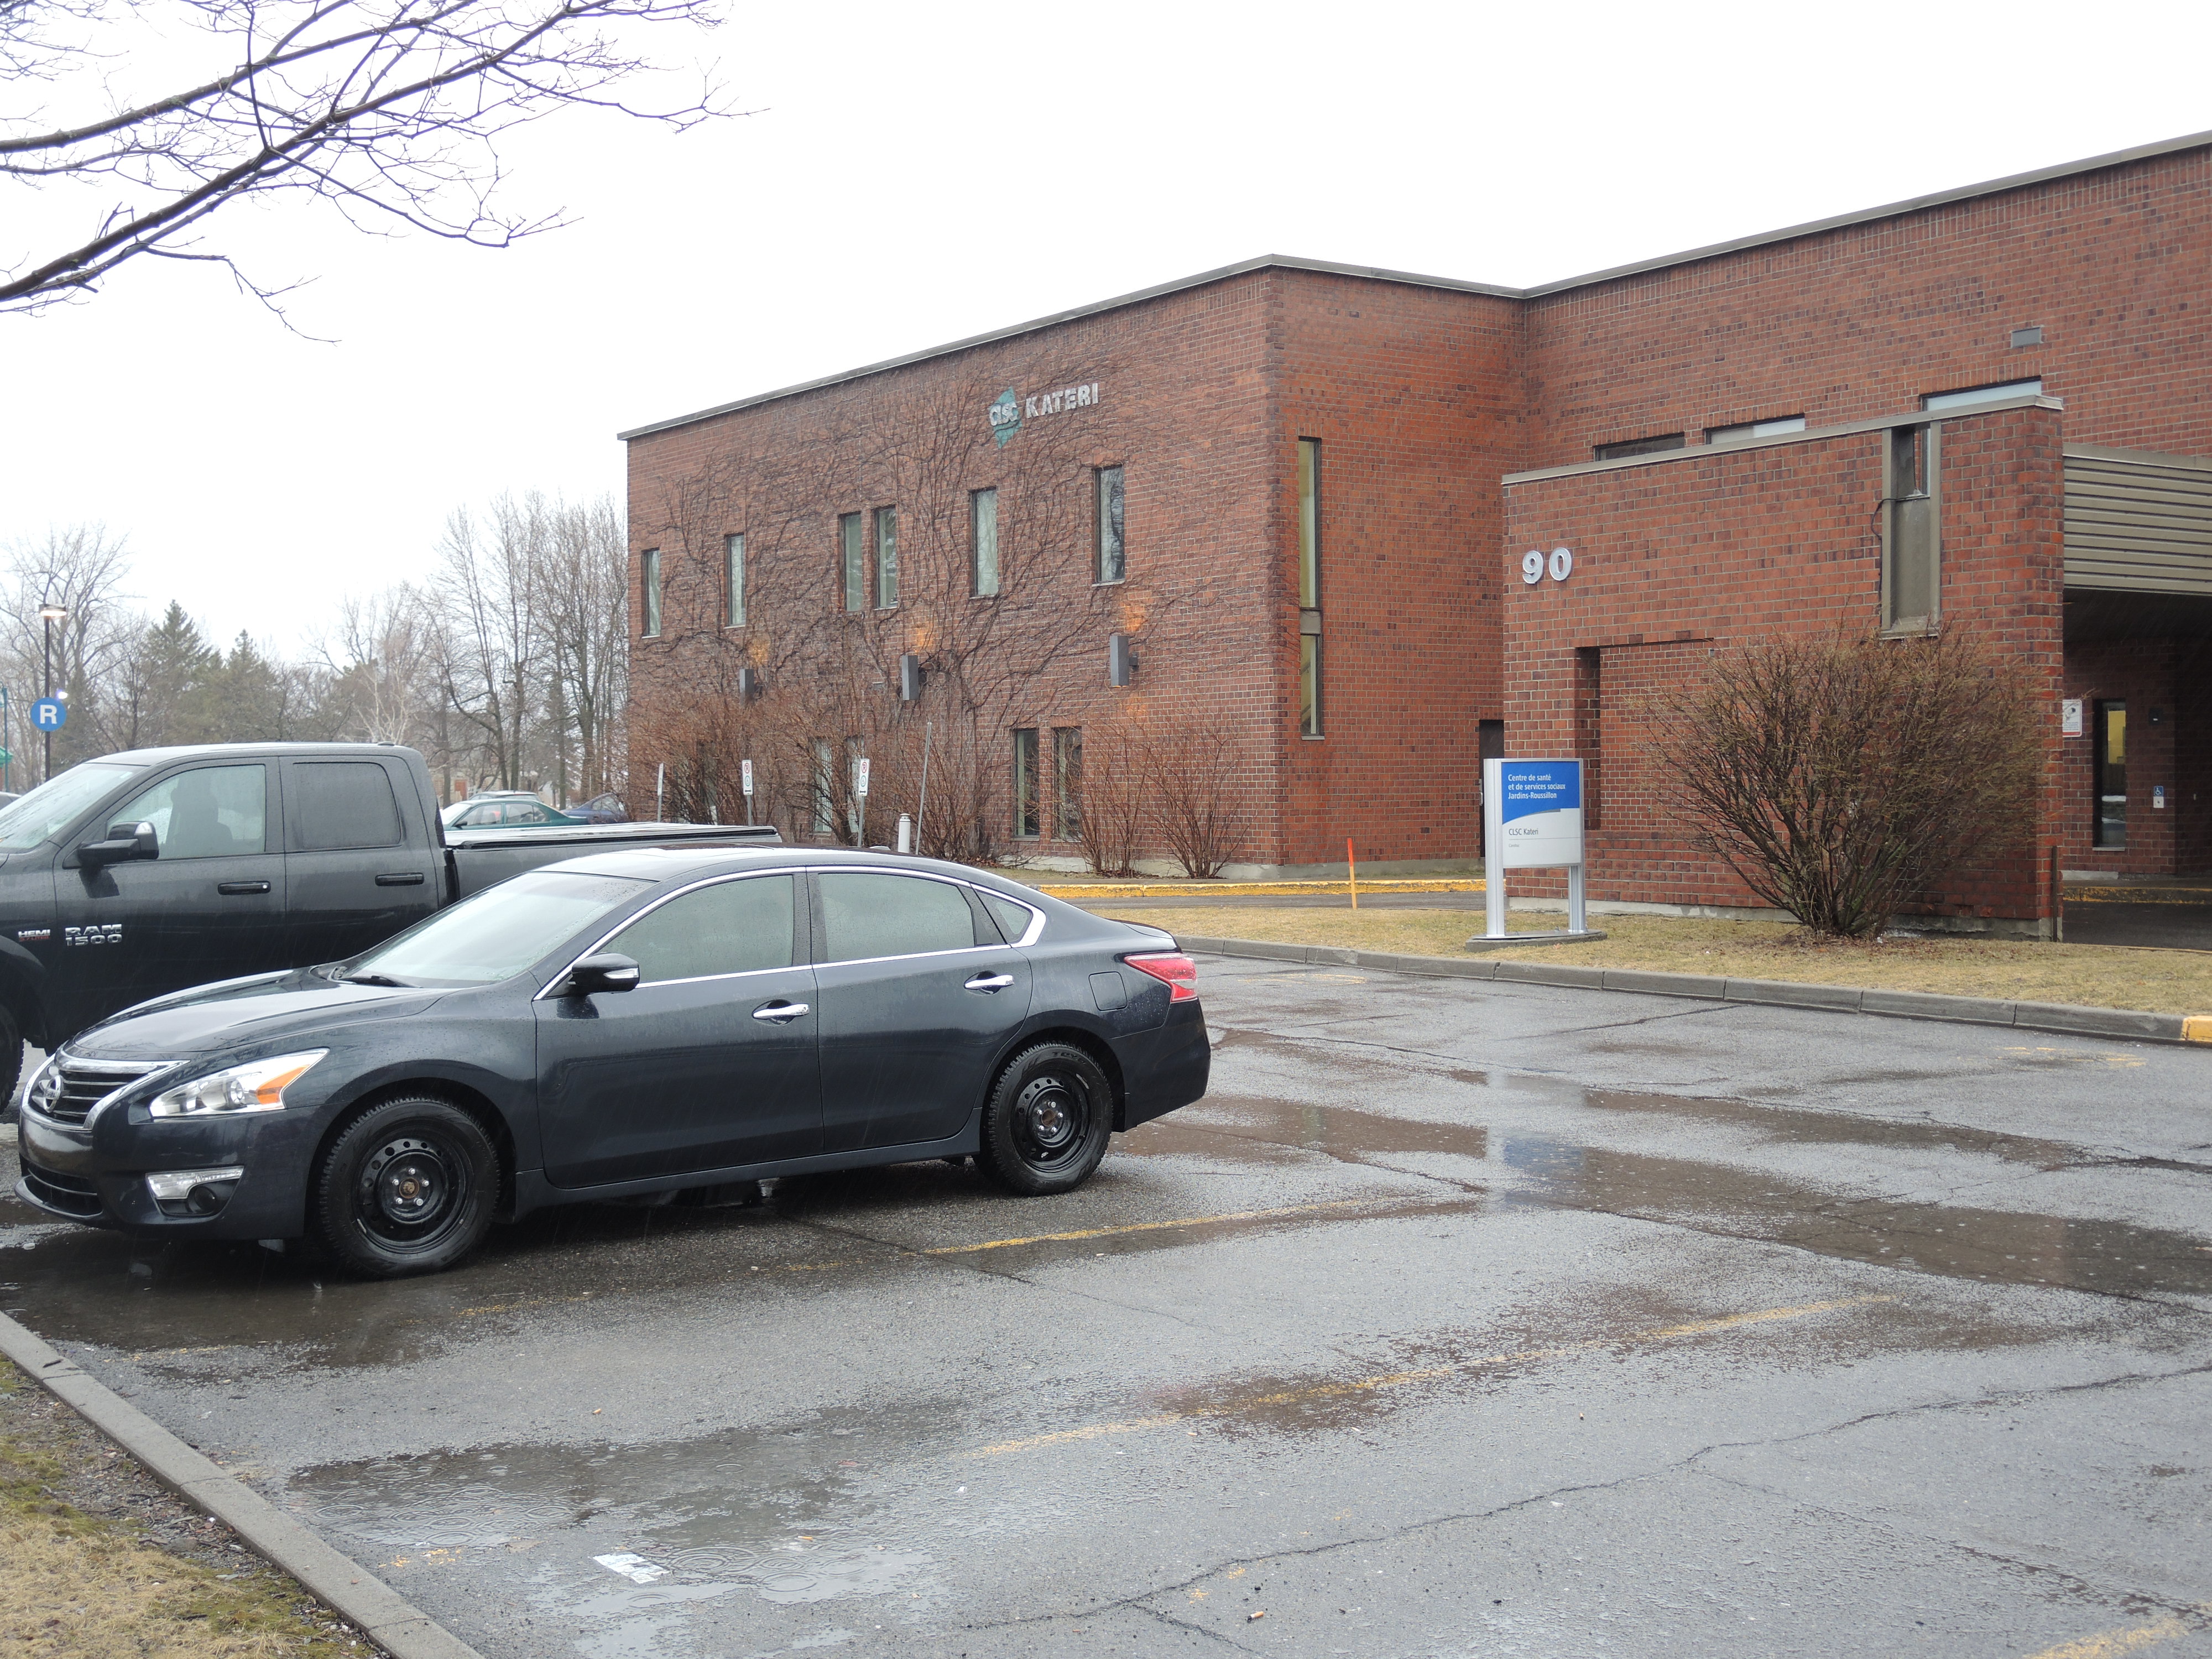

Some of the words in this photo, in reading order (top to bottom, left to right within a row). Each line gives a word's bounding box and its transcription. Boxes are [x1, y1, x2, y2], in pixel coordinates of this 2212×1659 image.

[1026, 383, 1099, 419] KATERI
[1522, 547, 1572, 584] 90
[40, 705, 57, 724] R
[18, 929, 50, 938] HEMI
[65, 924, 122, 937] RAM
[65, 933, 122, 946] 1500
